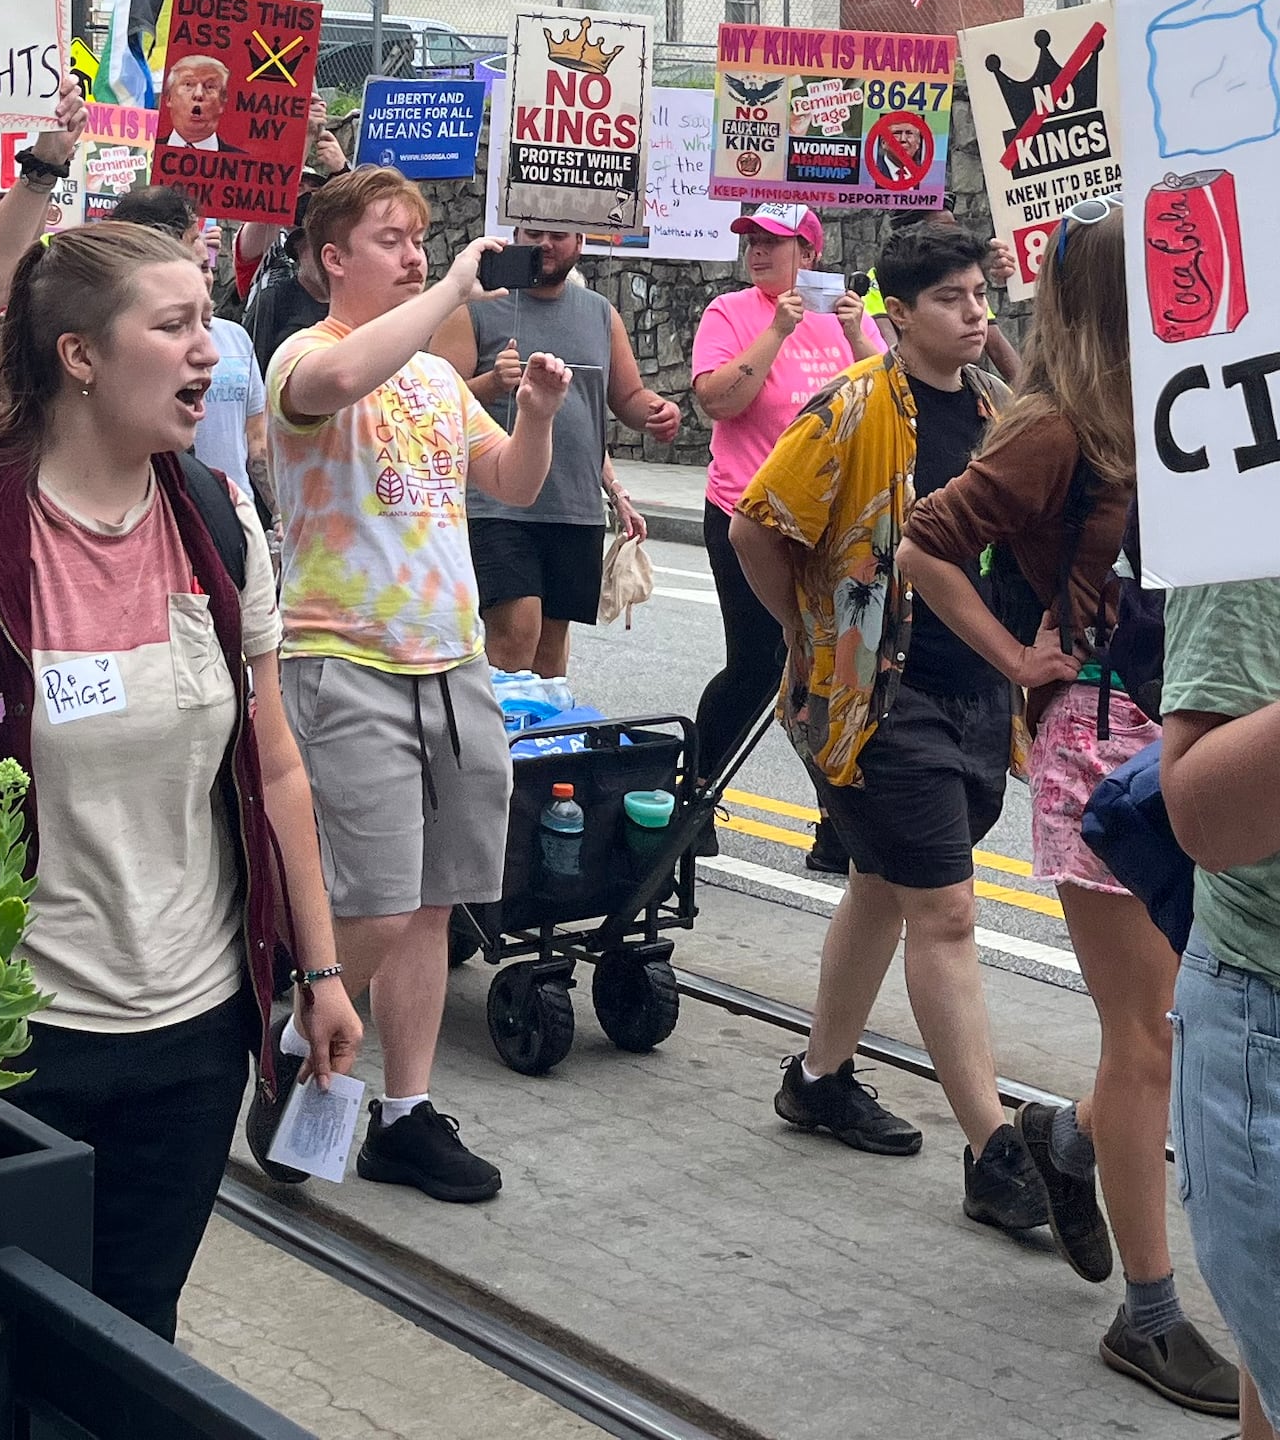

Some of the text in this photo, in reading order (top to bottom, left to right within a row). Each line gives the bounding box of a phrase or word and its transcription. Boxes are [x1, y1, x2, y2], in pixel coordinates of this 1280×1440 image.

[257, 2, 315, 31] THIS
[173, 21, 231, 49] ASS
[721, 27, 950, 74] MY KINK IS KARMA
[545, 70, 612, 110] NO
[810, 78, 841, 95] in my
[867, 79, 948, 111] 8647
[235, 91, 306, 118] MAKE
[386, 92, 464, 105] LIBERTY AND
[793, 89, 862, 111] feminine
[1032, 83, 1075, 116] NO
[368, 106, 473, 120] JUSTICE FOR ALL
[651, 106, 668, 127] ill
[735, 106, 768, 121] NO
[813, 107, 848, 124] rage
[120, 110, 139, 140] IS
[249, 118, 287, 141] MY
[368, 120, 474, 140] MEANS ALL.
[516, 106, 637, 149] KINGS
[724, 120, 779, 137] FAUX-ING
[726, 136, 775, 152] KING
[793, 140, 857, 157] WOMEN
[1015, 120, 1107, 171] KINGS
[88, 156, 145, 173] feminine
[160, 152, 296, 187] COUNTRY
[519, 147, 631, 171] PROTEST WHILE
[676, 156, 704, 173] the
[105, 170, 134, 185] rage
[520, 165, 624, 188] YOU STILL CAN
[797, 166, 852, 179] TRUMP
[671, 178, 709, 196] thes
[713, 185, 938, 207] KEEP IMMIGRANTS DEPORT TRUMP
[1005, 164, 1122, 207] KNEW IT'D BE BA
[221, 188, 290, 215] SMALL
[1023, 201, 1050, 222] BUT
[42, 669, 117, 714] PAIGE
